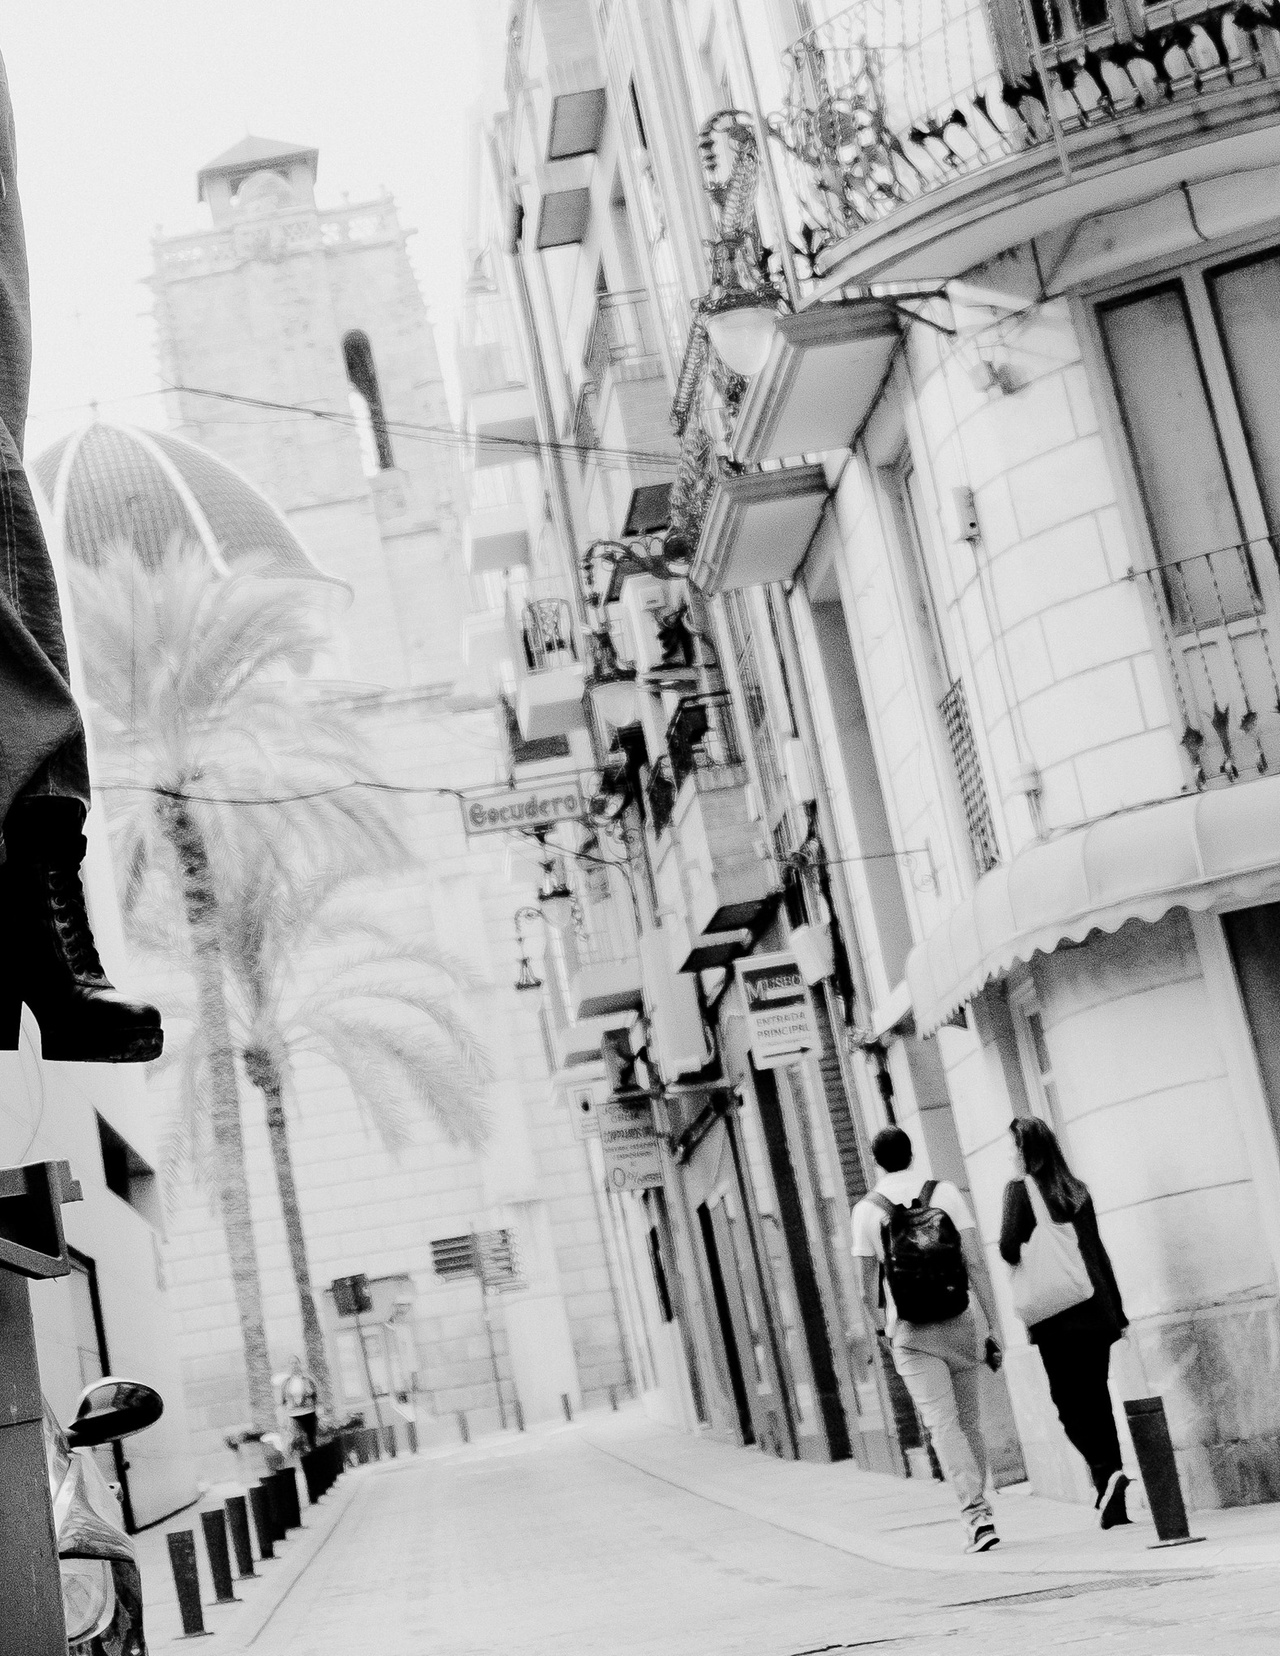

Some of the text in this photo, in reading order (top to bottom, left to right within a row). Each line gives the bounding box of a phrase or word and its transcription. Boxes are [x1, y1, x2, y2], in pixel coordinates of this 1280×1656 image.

[744, 975, 801, 1004] MUSEO
[756, 1012, 807, 1027] ENTRADA
[757, 1023, 810, 1038] PRINCIPAL
